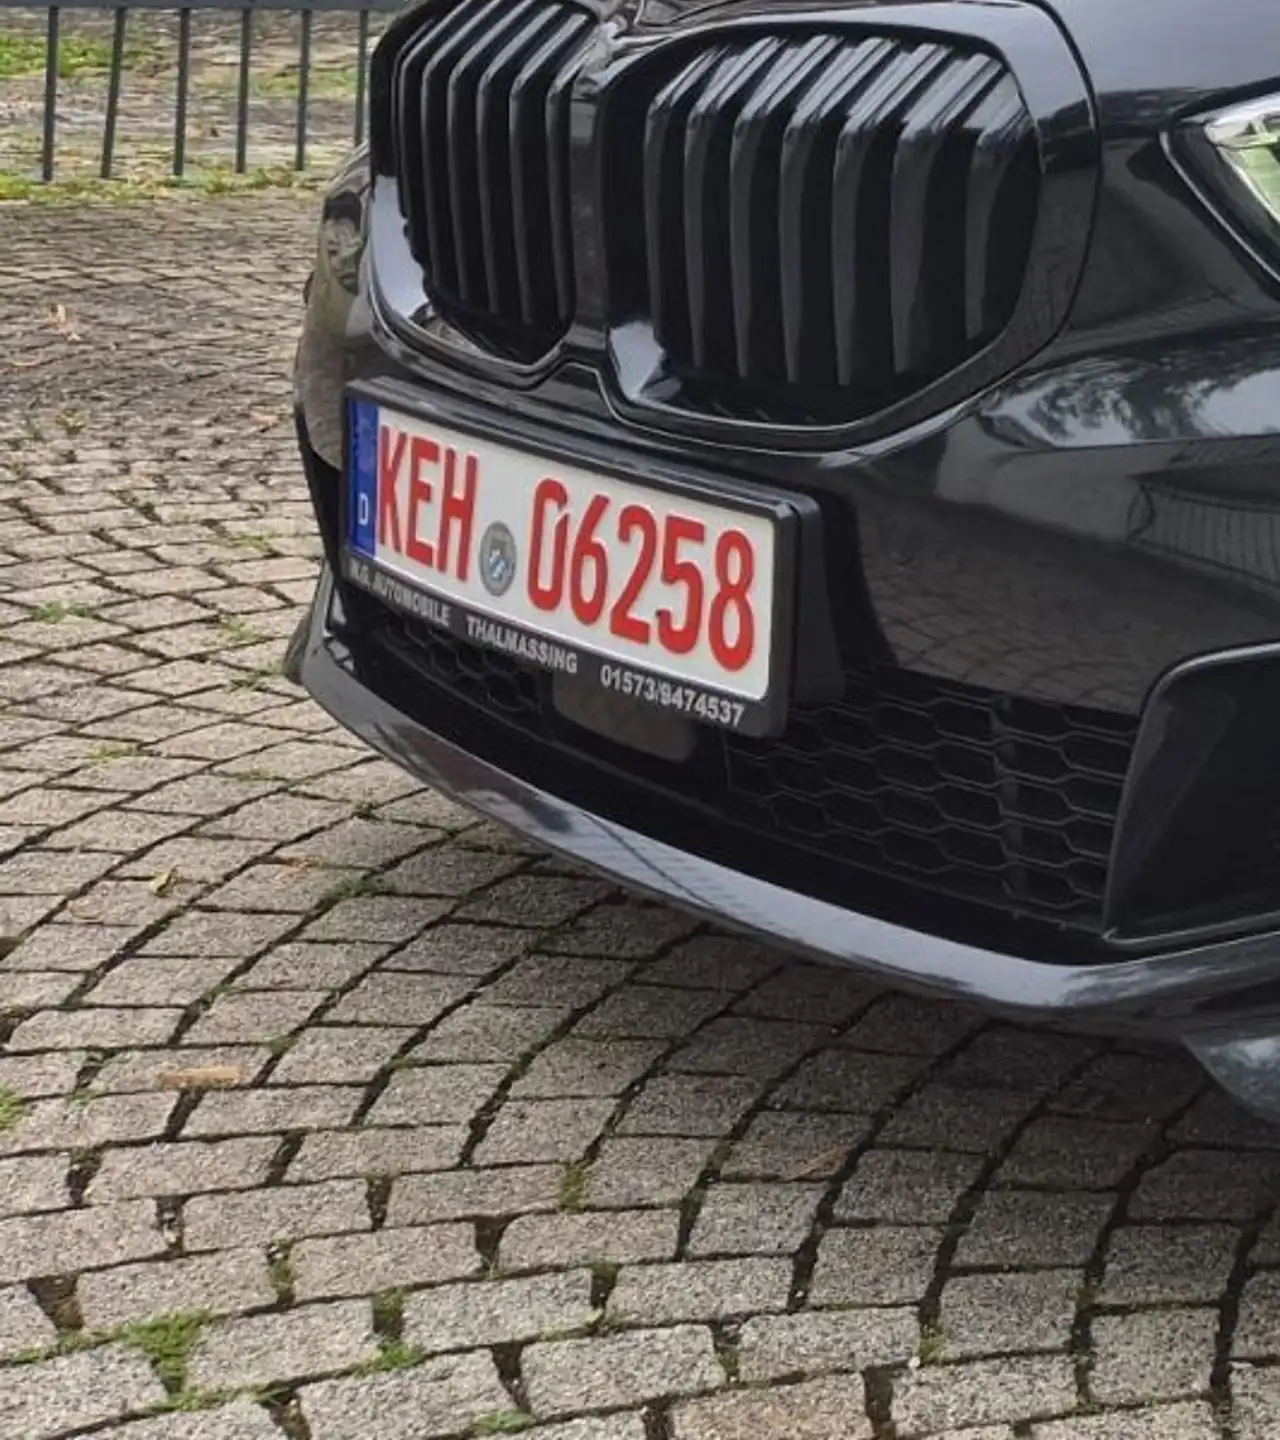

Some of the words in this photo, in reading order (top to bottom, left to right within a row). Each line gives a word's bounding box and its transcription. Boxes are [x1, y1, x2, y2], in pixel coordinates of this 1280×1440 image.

[358, 491, 369, 526] D
[379, 425, 478, 582] KEH
[528, 477, 756, 673] 06258
[372, 570, 451, 627] AUTOMOBILE
[465, 614, 578, 674] THALMASSING
[600, 664, 745, 727] 01573/9474537
